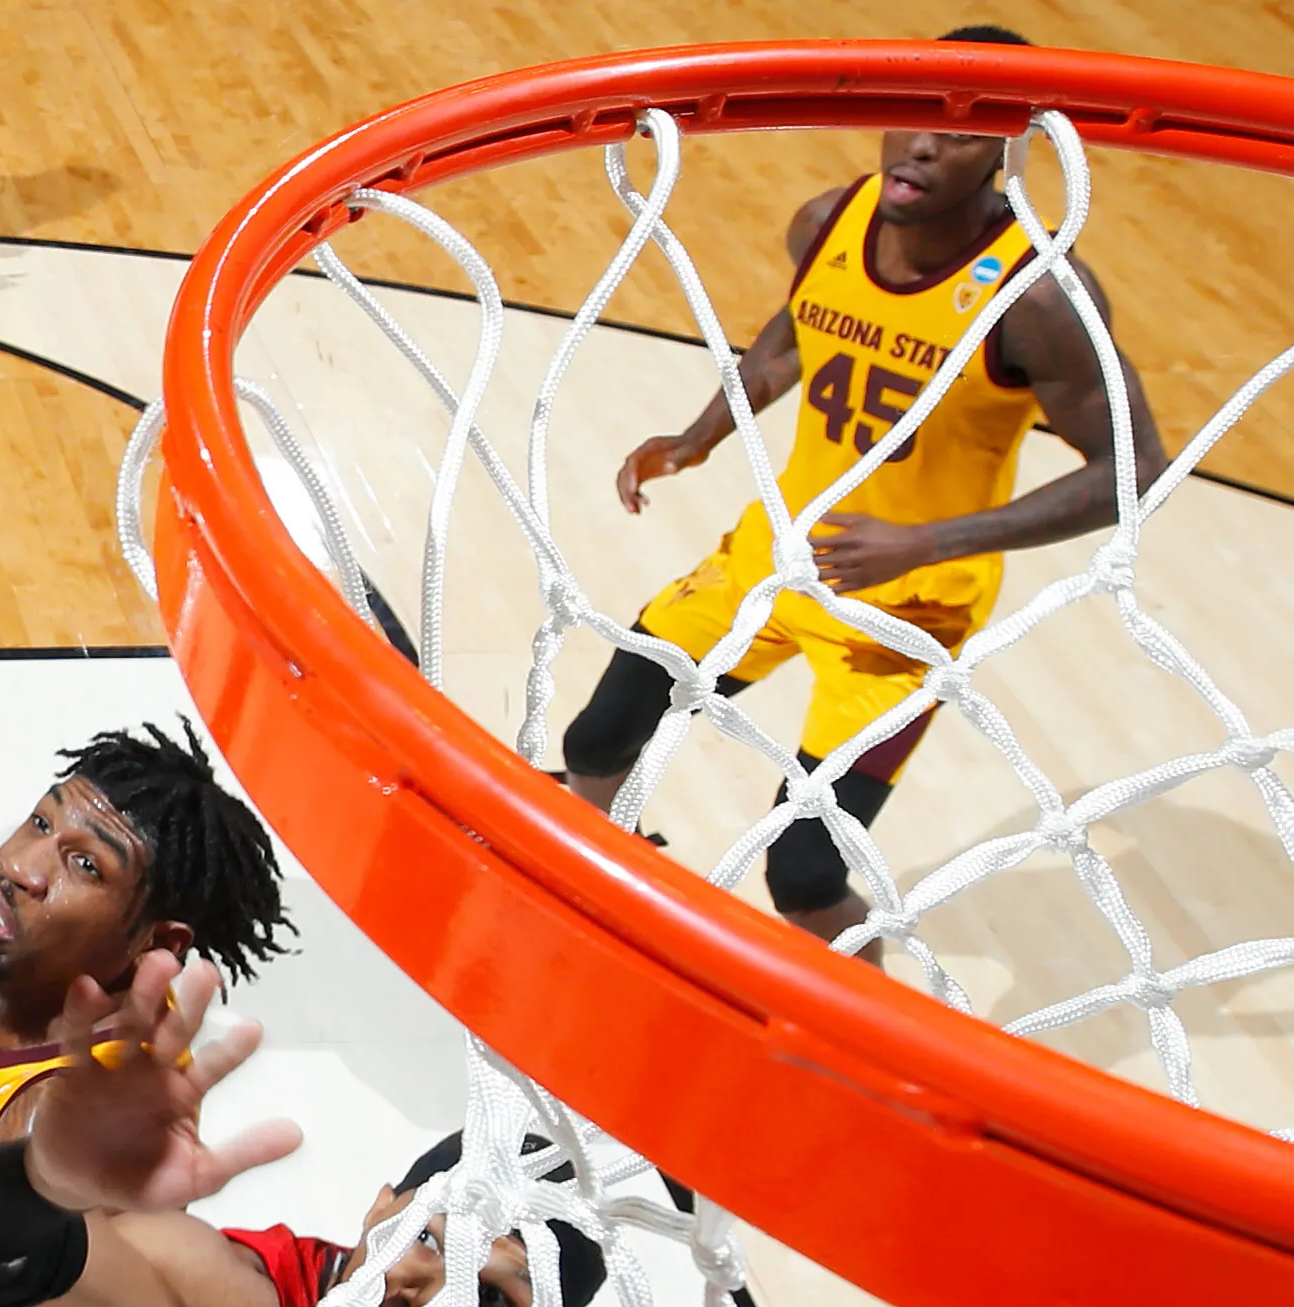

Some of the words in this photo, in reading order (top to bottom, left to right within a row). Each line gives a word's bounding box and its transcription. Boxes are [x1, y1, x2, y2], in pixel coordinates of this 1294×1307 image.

[796, 300, 884, 352] ARIZONA
[889, 332, 960, 377] STAT
[807, 351, 924, 463] 45
